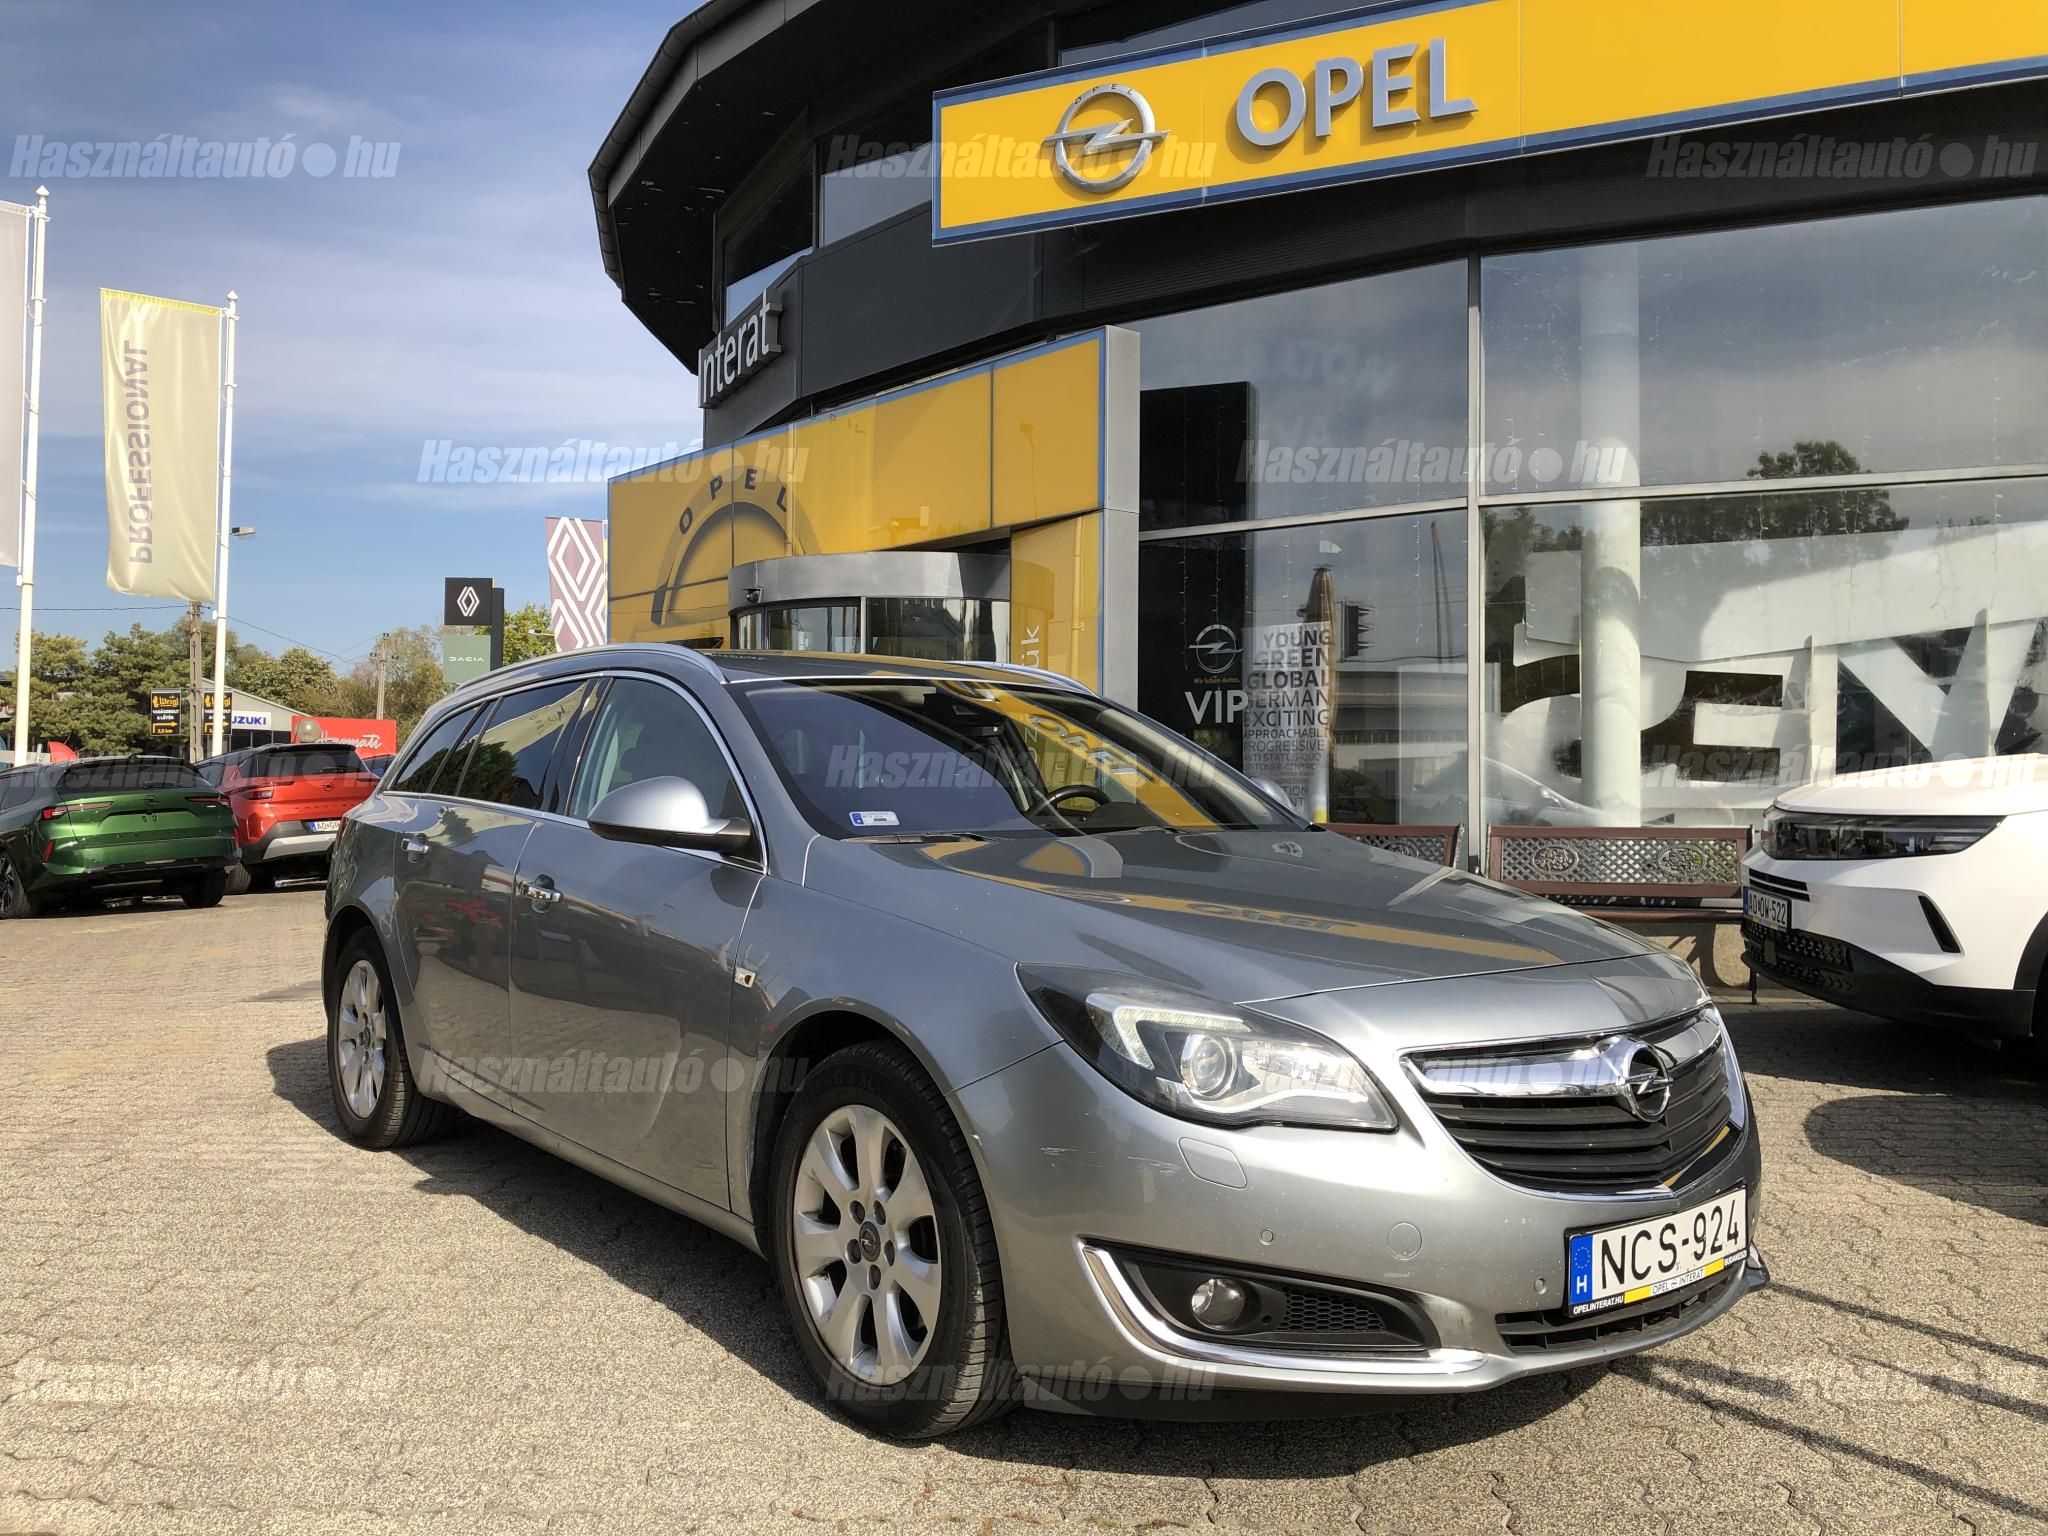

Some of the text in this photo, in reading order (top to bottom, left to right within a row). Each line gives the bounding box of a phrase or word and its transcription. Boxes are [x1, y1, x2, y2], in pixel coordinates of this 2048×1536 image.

[1236, 37, 1479, 147] OPEL
[679, 468, 788, 535] OPEL
[1264, 629, 1330, 649] YOUNG
[1247, 670, 1329, 690] GLOBAL
[1184, 689, 1249, 725] VIP
[1243, 709, 1329, 728] EXCITING
[1601, 1200, 1739, 1290] NCS-924
[1576, 1274, 1588, 1295] H
[1652, 1269, 1704, 1294] OPEL INTERAT
[1573, 1296, 1624, 1315] OPELINTERAT.HU
